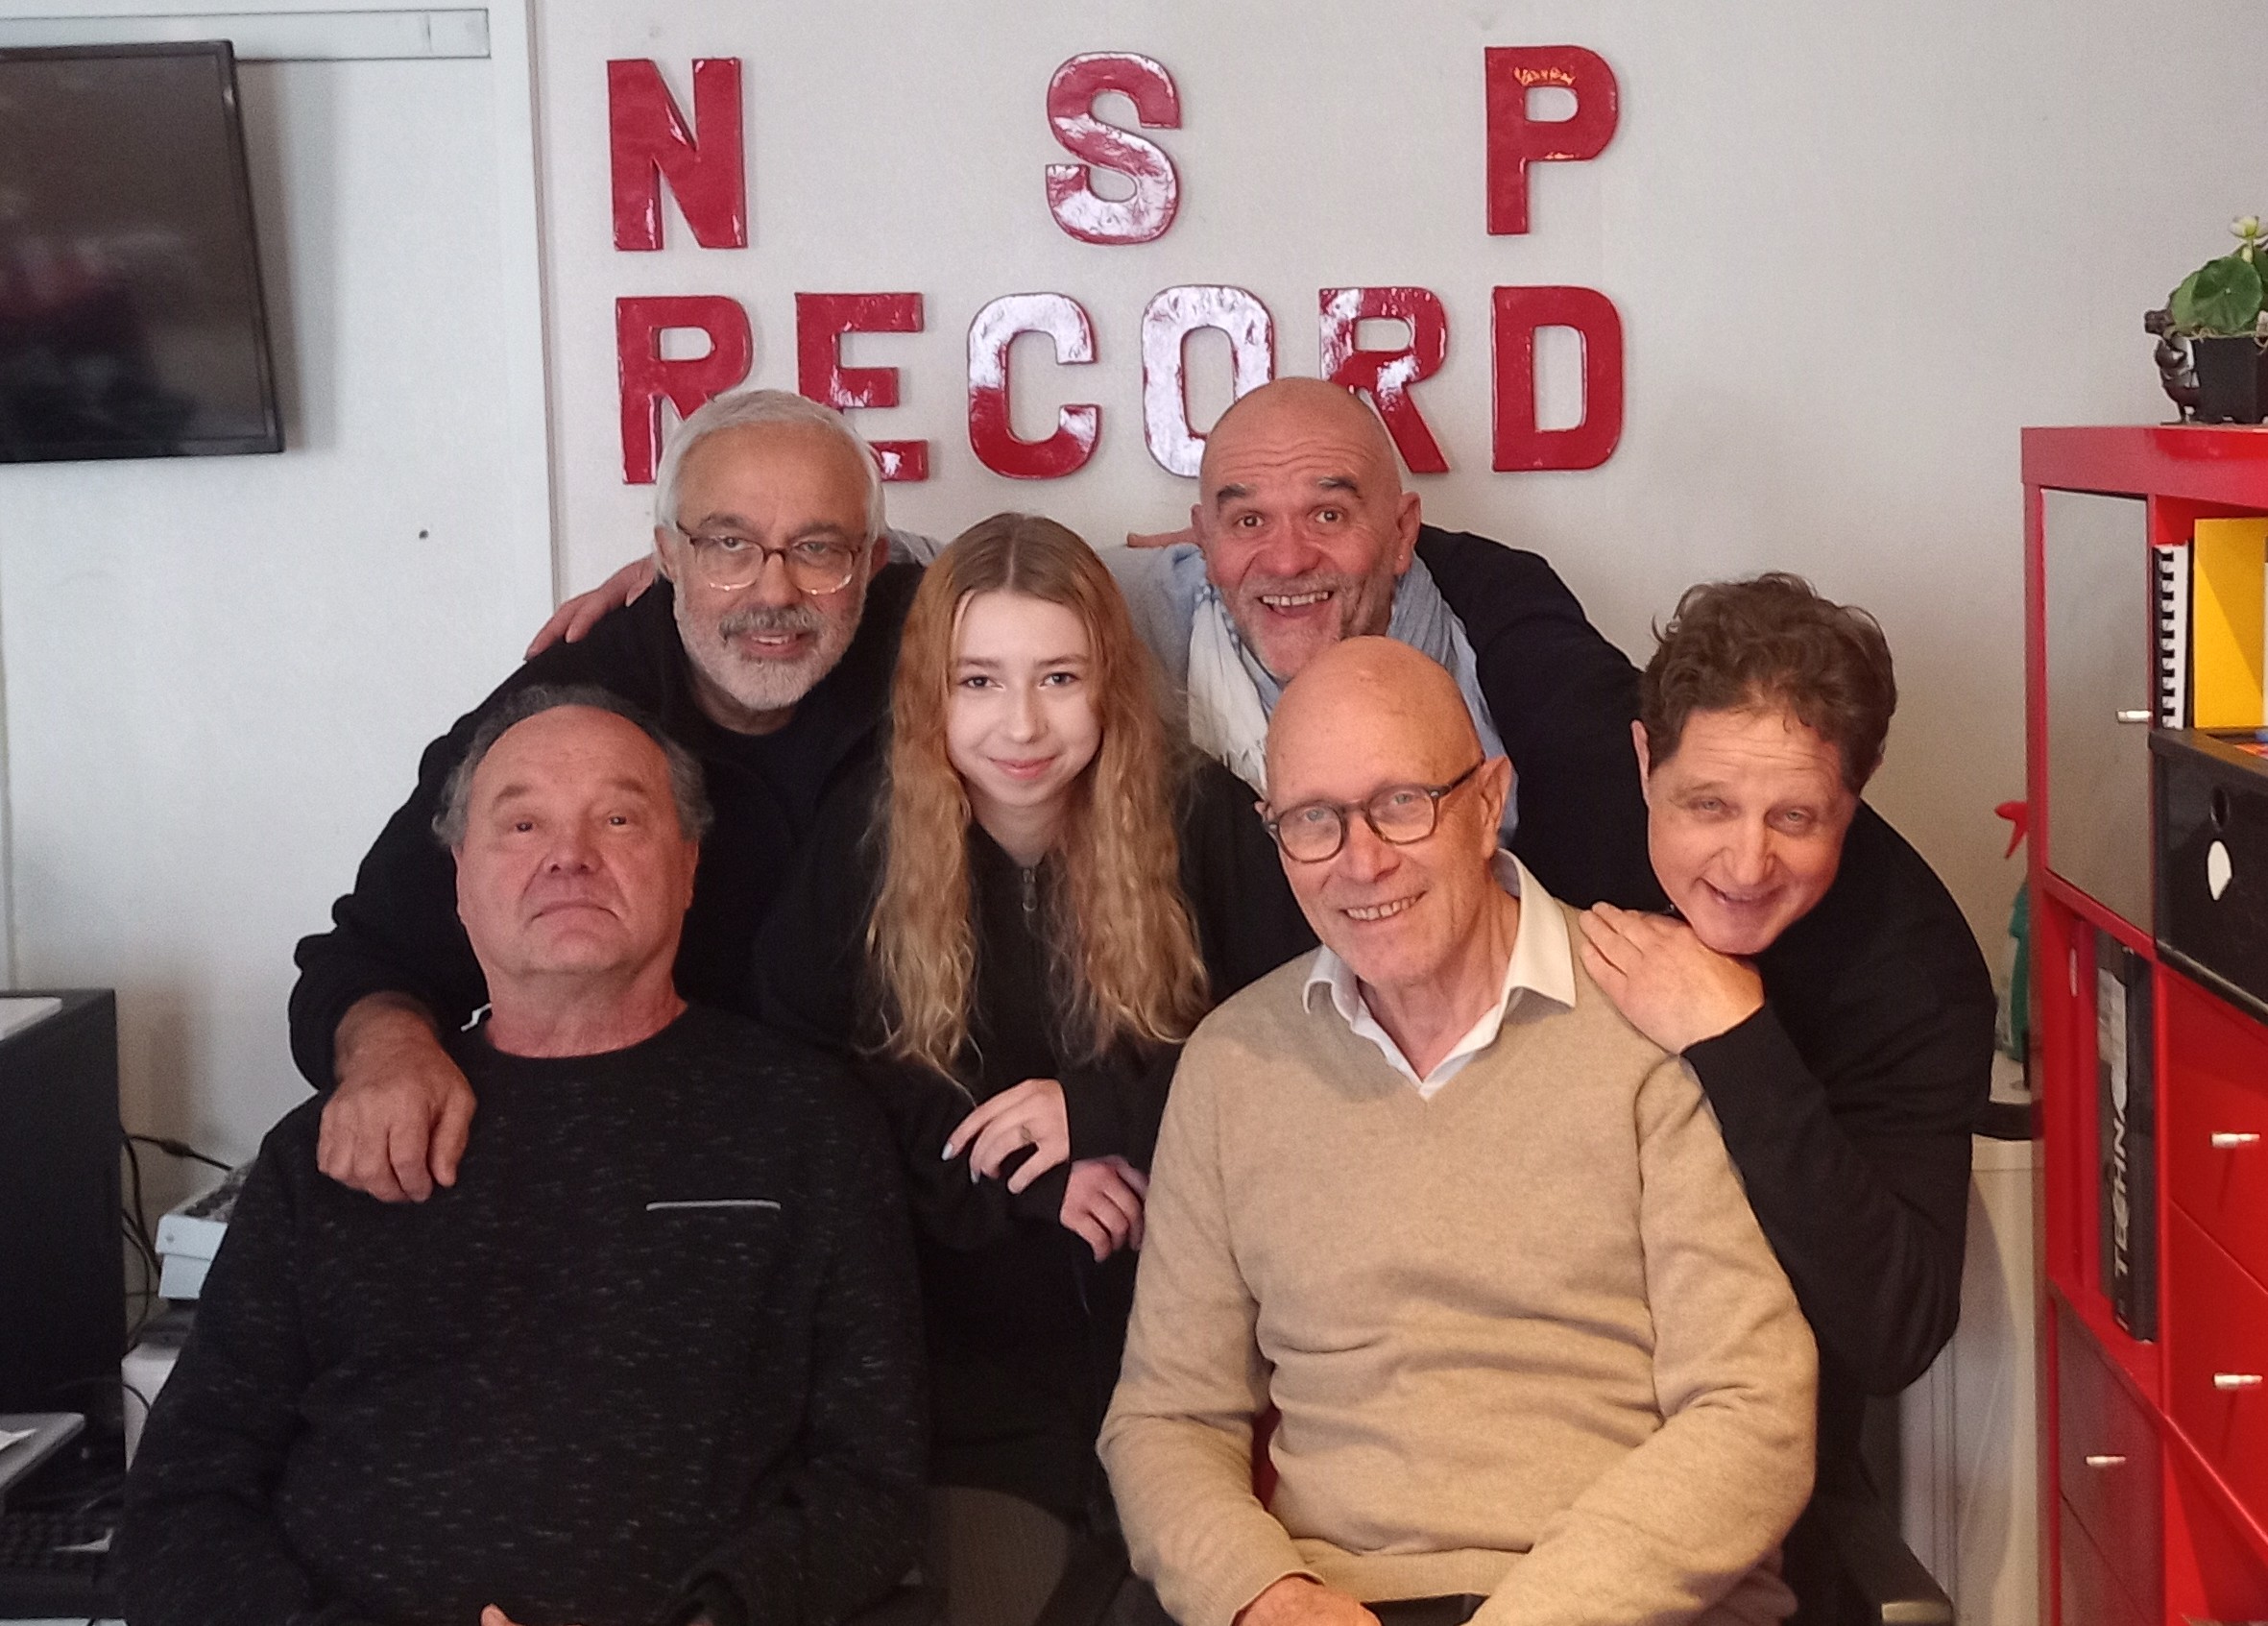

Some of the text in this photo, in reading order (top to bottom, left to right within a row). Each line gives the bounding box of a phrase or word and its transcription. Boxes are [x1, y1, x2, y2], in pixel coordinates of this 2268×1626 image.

[607, 45, 1619, 252] N S P
[616, 284, 1625, 485] RECORD
